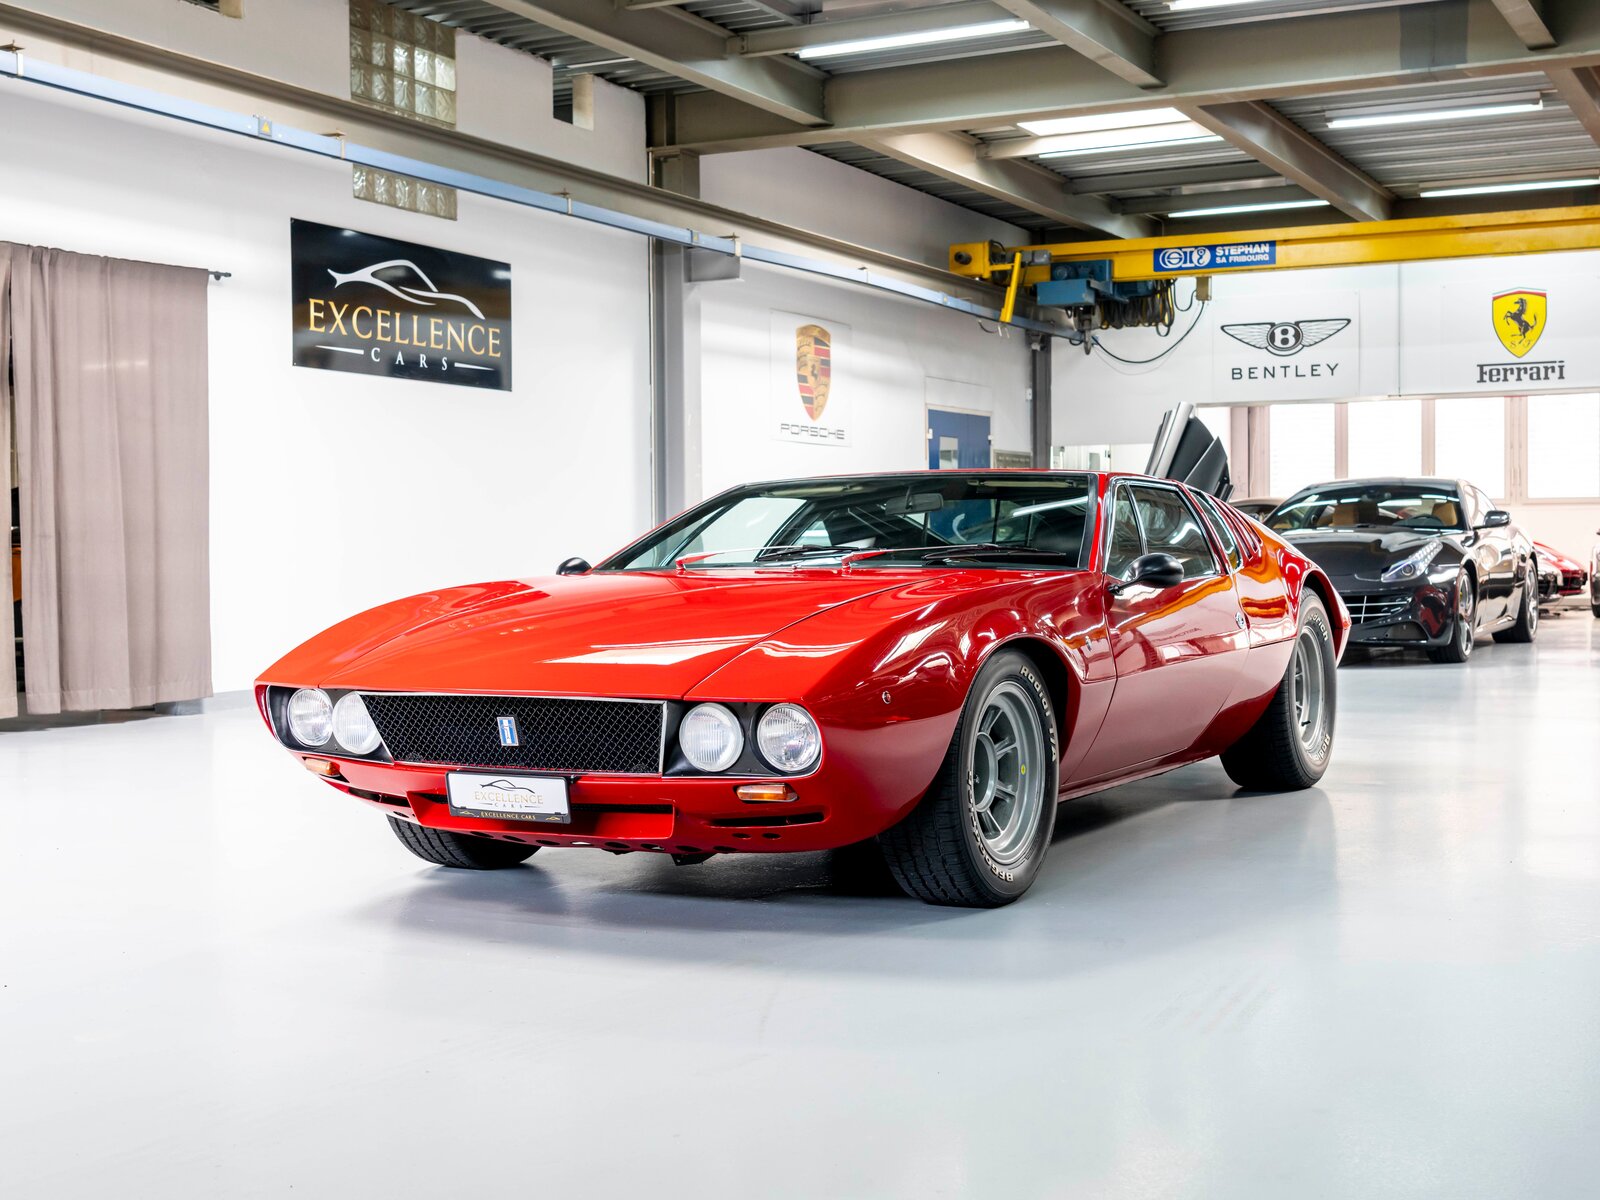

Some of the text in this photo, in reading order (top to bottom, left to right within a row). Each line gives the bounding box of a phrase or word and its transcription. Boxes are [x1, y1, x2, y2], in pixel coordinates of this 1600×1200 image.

[1215, 243, 1270, 256] STEPHAN
[1215, 256, 1227, 264] SA
[1228, 253, 1270, 263] FRIBOURG
[308, 298, 502, 358] EXCELLENCE
[370, 347, 448, 371] CARS
[1231, 362, 1339, 380] BENTLEY
[1476, 360, 1565, 383] Ferrari
[780, 423, 845, 440] PORSCHE
[1020, 665, 1057, 762] Radial T/A
[474, 791, 544, 804] EXCELLENCE
[480, 811, 519, 819] EXCELLENCE
